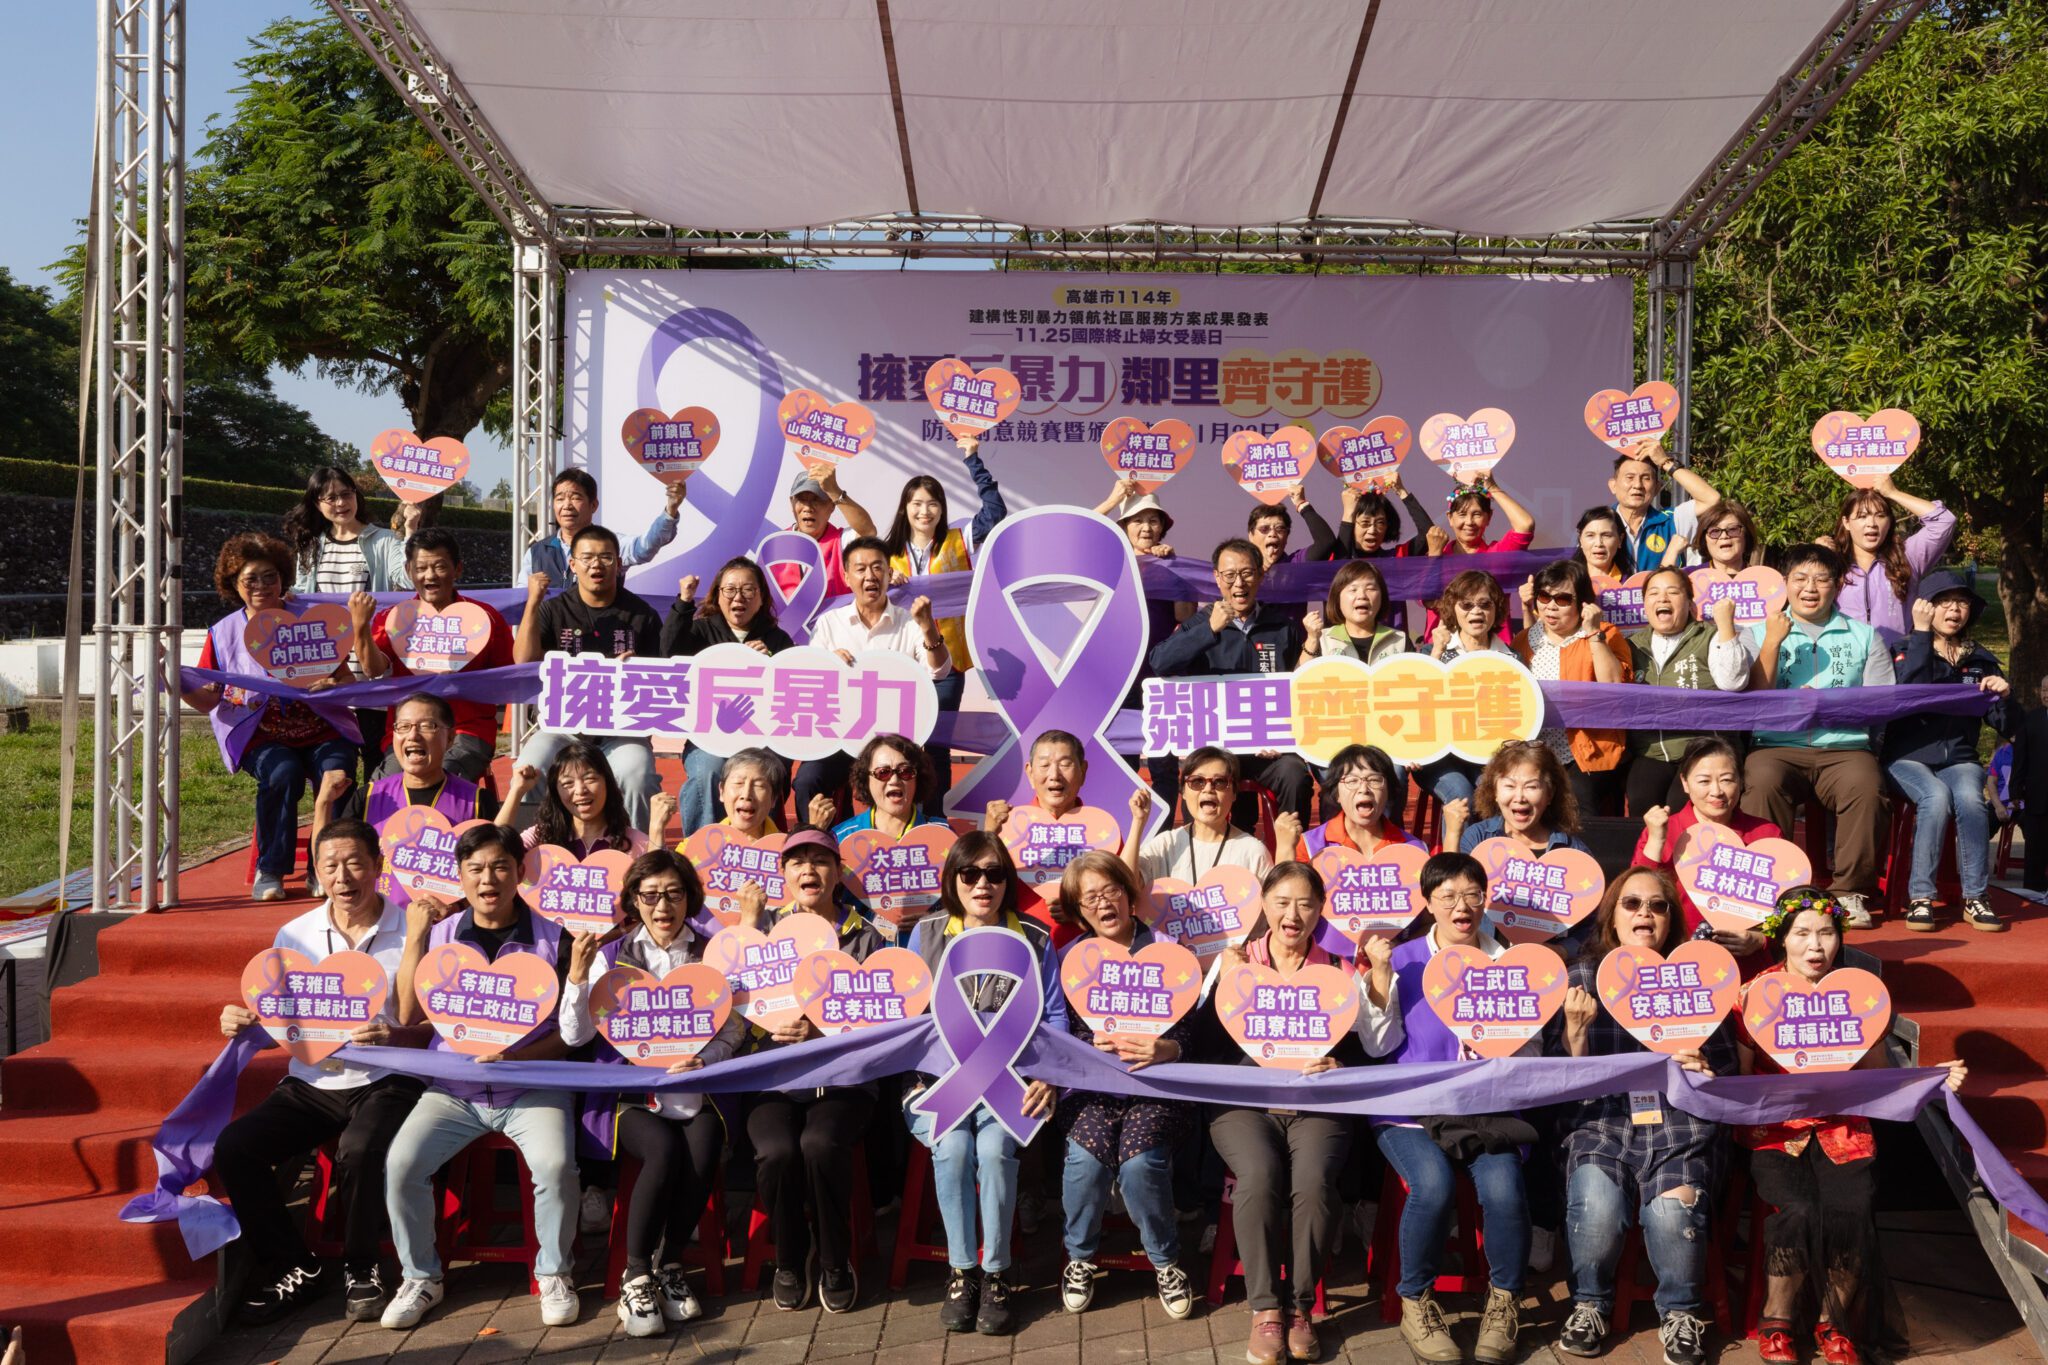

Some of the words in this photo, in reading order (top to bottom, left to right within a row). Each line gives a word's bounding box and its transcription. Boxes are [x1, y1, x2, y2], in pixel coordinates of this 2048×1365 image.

[1066, 289, 1171, 305] 高雄市114年
[969, 310, 1269, 326] 建構性別暴力領航社區服務方案成果發表
[1015, 327, 1222, 345] 11.25國際終止婦女受暴日
[952, 376, 994, 397] 鼓山區
[1121, 356, 1372, 406] 鄰里齊守護
[1612, 398, 1652, 418] 三民區
[650, 422, 692, 440] 前鎮區
[809, 410, 846, 431] 小港區
[1447, 423, 1488, 440] 湖內區
[1607, 413, 1661, 436] 河堤社區
[788, 422, 858, 452] 山明水秀社區
[1129, 435, 1169, 450] 梓官區
[1344, 433, 1384, 454] 湖內區
[1846, 427, 1886, 441] 三民區
[402, 445, 440, 462] 前鎮區
[644, 441, 700, 459] 興邦社區
[1120, 453, 1174, 468] 梓信社區
[1250, 443, 1290, 460] 湖內區
[1827, 442, 1906, 458] 幸福千歲社區
[381, 457, 456, 480] 幸福興東社區
[1244, 460, 1298, 479] 湖庄社區
[1711, 583, 1756, 599] 杉林區
[1704, 602, 1765, 618] 新社區
[278, 622, 326, 642] 內門區
[416, 616, 460, 634] 六龜區
[271, 642, 337, 664] 內門社區
[407, 635, 466, 653] 文武社區
[545, 657, 916, 740] 擁愛反暴力
[1149, 672, 1524, 751] 鄰里齊守護
[420, 829, 457, 852] 鳳山
[1031, 826, 1084, 844] 旗津區
[723, 845, 779, 872] 林園區
[873, 847, 927, 869] 大寮區
[1022, 848, 1092, 867] 中華社
[1713, 846, 1773, 878] 橋頭區
[552, 866, 606, 888] 大寮區
[865, 869, 938, 893] 義仁社區
[1342, 867, 1398, 887] 大社區
[1506, 859, 1567, 888] 楠梓區
[1697, 868, 1777, 904] 東林社區
[542, 890, 614, 914] 溪寮社區
[1171, 886, 1226, 913] 甲仙區
[1334, 891, 1409, 912] 保社社區
[1492, 884, 1572, 914] 大昌社區
[1167, 909, 1240, 939] 甲仙社區
[746, 940, 797, 966] 鳳山區
[288, 975, 341, 995] 苓雅區
[461, 972, 513, 997] 苓雅區
[833, 972, 892, 994] 鳳山區
[1101, 963, 1161, 988] 路竹區
[1465, 968, 1525, 991] 仁武區
[1639, 964, 1700, 987] 三民區
[260, 997, 366, 1019] 幸福意誠社區
[431, 992, 536, 1024] 幸福仁政社區
[631, 988, 691, 1011] 鳳山區
[825, 999, 904, 1020] 忠孝社區
[1090, 989, 1170, 1014] 社南社區
[1257, 988, 1317, 1011] 路竹區
[1456, 996, 1540, 1019] 烏林社區
[1633, 991, 1713, 1017] 安泰社區
[1786, 994, 1848, 1018] 旗山區
[611, 1013, 712, 1039] 新過埤社區
[1247, 1015, 1328, 1039] 頂寮社區
[1778, 1022, 1862, 1046] 廣福社區
